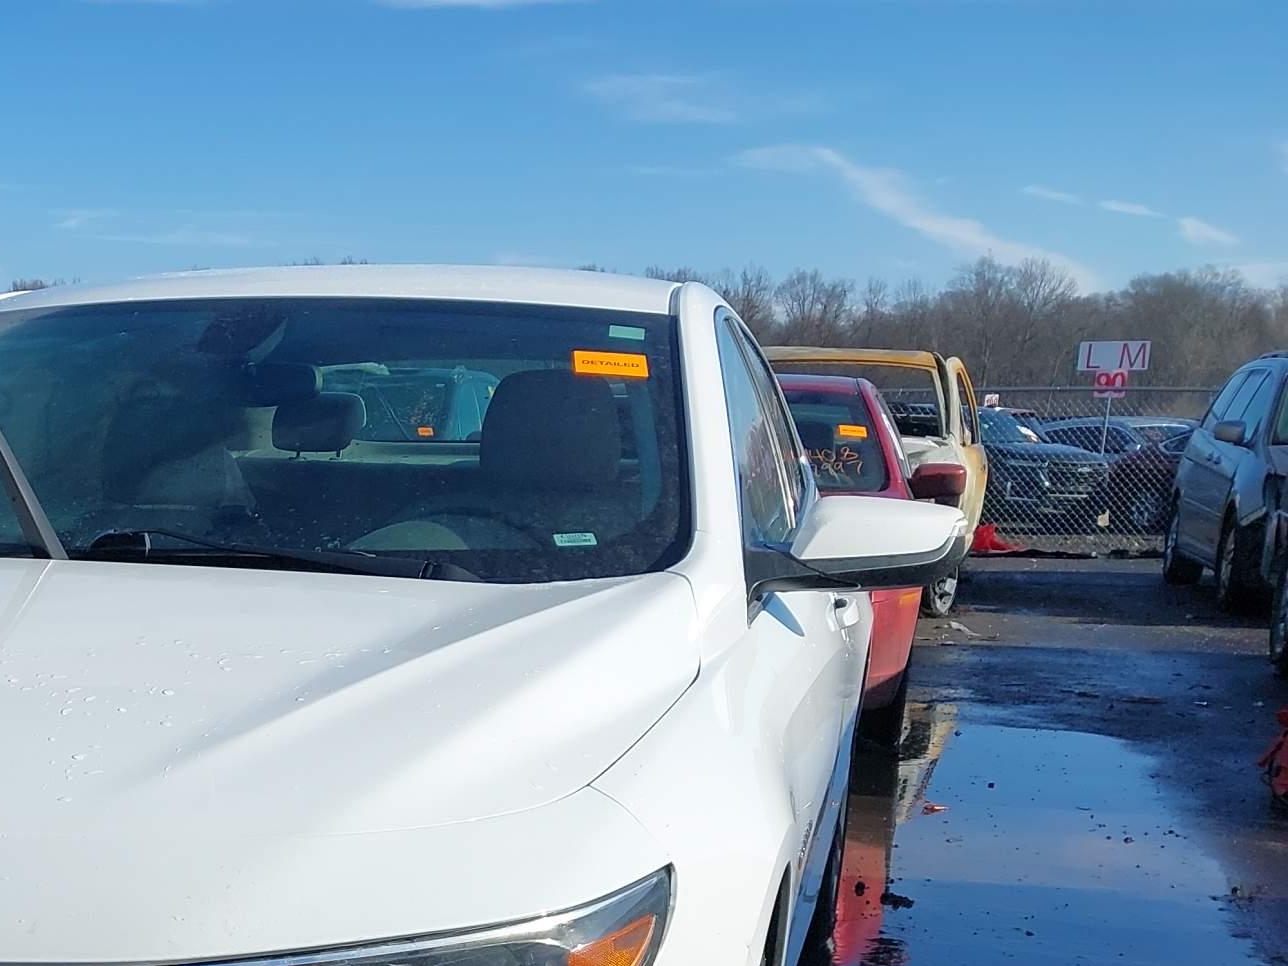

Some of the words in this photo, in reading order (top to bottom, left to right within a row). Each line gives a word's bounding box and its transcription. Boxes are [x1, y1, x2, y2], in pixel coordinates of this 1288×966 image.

[581, 359, 640, 369] DETAILED
[1086, 343, 1100, 369] L
[1118, 342, 1147, 369] M
